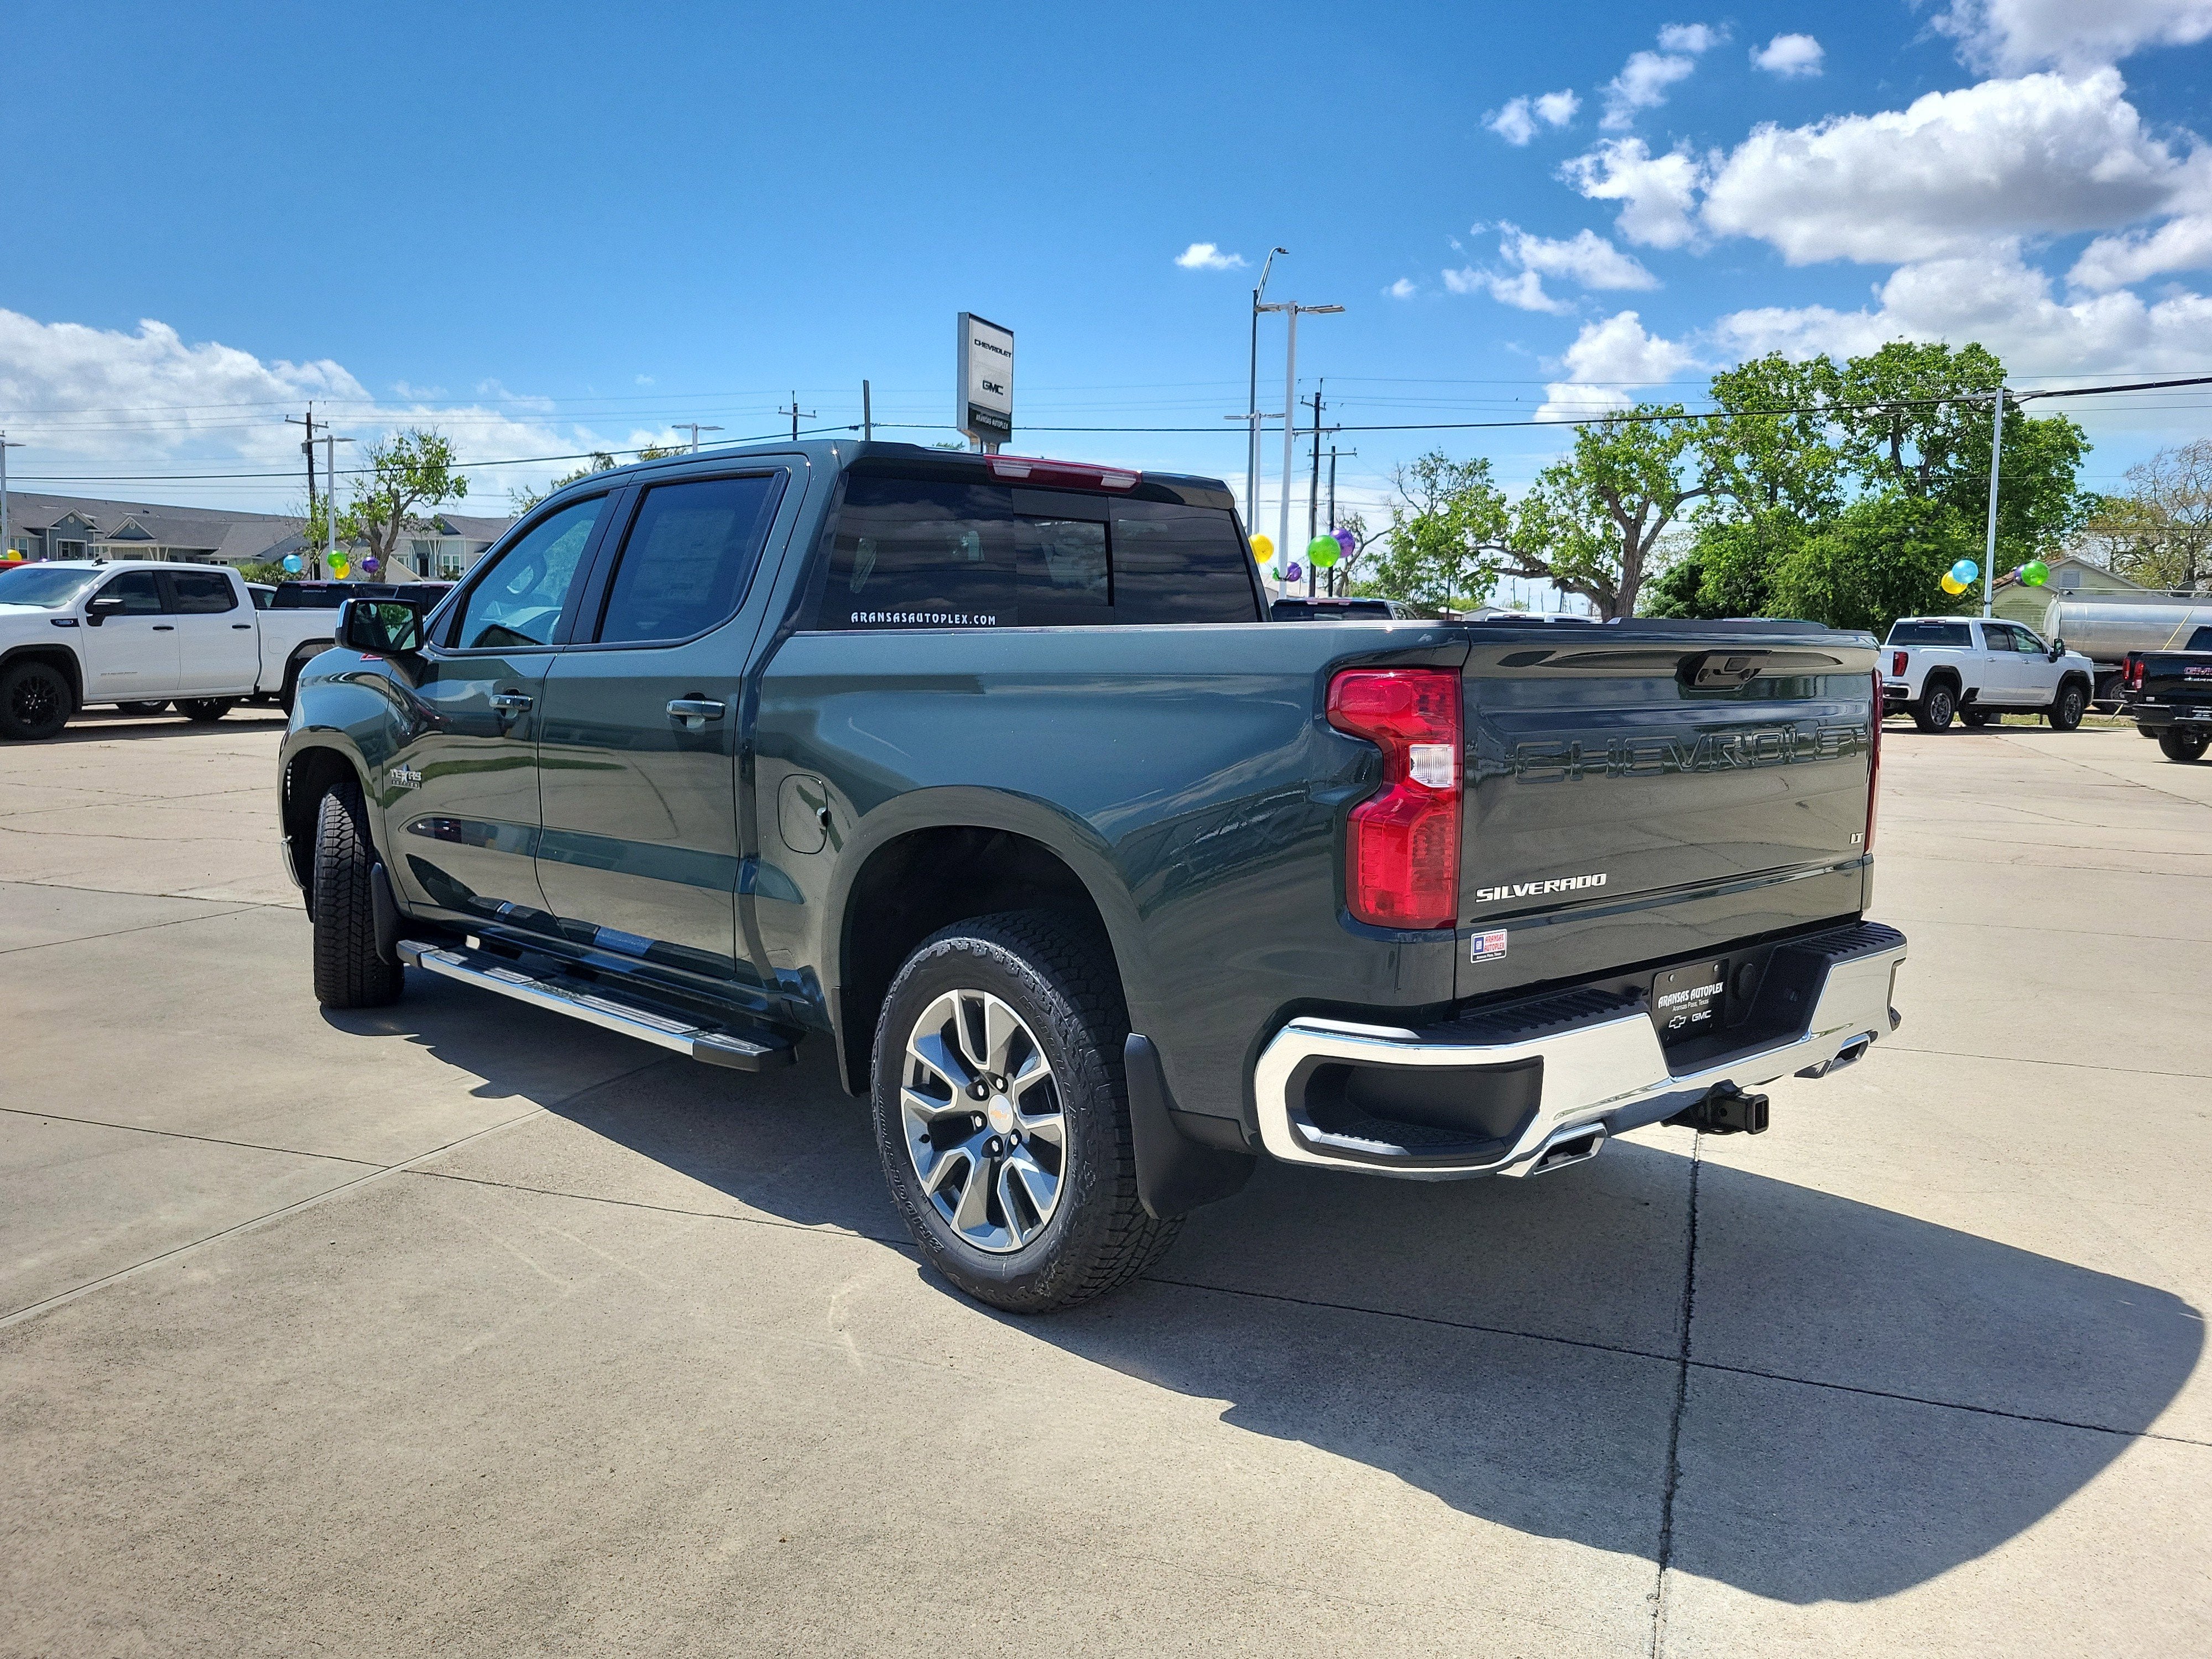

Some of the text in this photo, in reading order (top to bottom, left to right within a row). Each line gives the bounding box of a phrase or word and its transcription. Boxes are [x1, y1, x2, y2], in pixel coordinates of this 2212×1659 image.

[974, 338, 1011, 358] CHEVROLET
[982, 380, 1004, 395] GMC
[851, 612, 995, 625] ARANSASAUTOPLEX.COM
[1516, 723, 1866, 784] CHEVROLET
[1850, 833, 1864, 844] LT
[1475, 873, 1606, 902] SILVERADO
[1658, 982, 1723, 1009] ARANSAS AUTOPLEX
[1692, 1010, 1712, 1022] GMC
